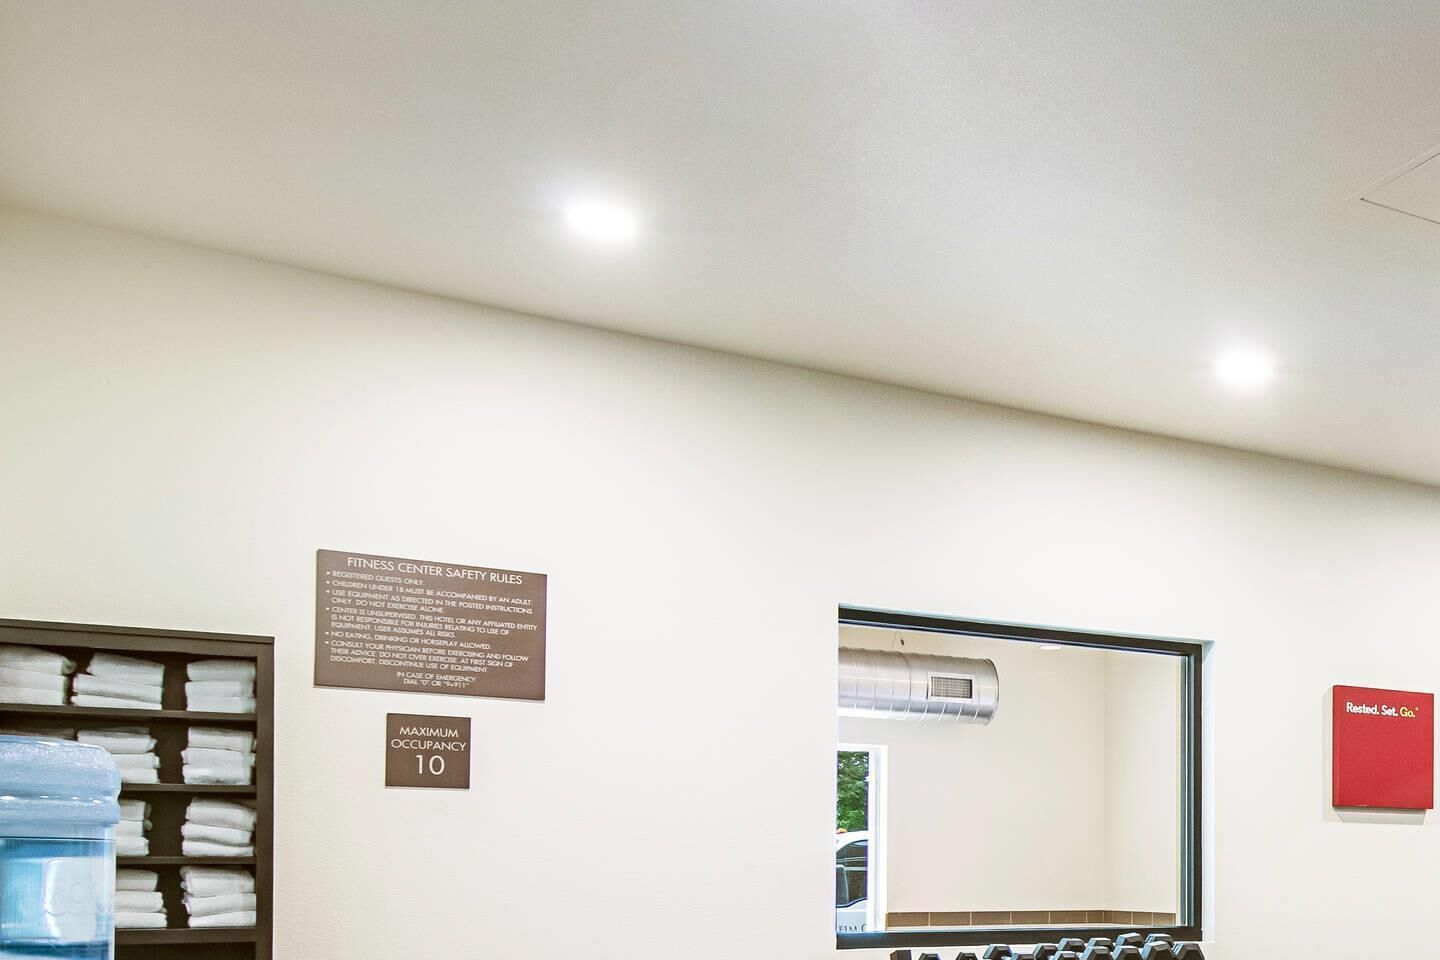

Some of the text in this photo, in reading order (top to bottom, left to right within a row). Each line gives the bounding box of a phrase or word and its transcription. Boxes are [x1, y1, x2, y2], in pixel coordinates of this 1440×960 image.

[347, 557, 522, 584] FITNESS CENTER SAFETY RULES
[333, 571, 373, 580] REGISTERED
[375, 575, 401, 584] GUESTS
[332, 581, 367, 589] CHILDREN
[406, 587, 424, 595] MUST
[436, 591, 487, 600] ACCOMPANIED
[348, 591, 388, 600] EQUIPMENT
[486, 605, 533, 614] INSTRUCTIONS
[387, 602, 418, 610] EXERCISE
[356, 616, 399, 626] RESPONSIBLE
[415, 620, 443, 629] INJURIES
[445, 624, 475, 633] RELATING
[393, 627, 424, 635] ASSUMES
[483, 621, 515, 629] AFFILIATED
[375, 635, 408, 643] DRINKING
[421, 638, 458, 647] HORSEPLAY
[385, 644, 420, 652] PHYSICIAN
[448, 650, 485, 658] EXERCISING
[379, 659, 424, 668] DISCONTINUE
[436, 674, 476, 682] EMERGENCY
[1346, 702, 1380, 715] Rested.
[1381, 705, 1399, 717] Set.
[399, 726, 458, 738] MAXIMUM
[391, 738, 467, 752] OCCUPANCY
[416, 754, 445, 775] 10
